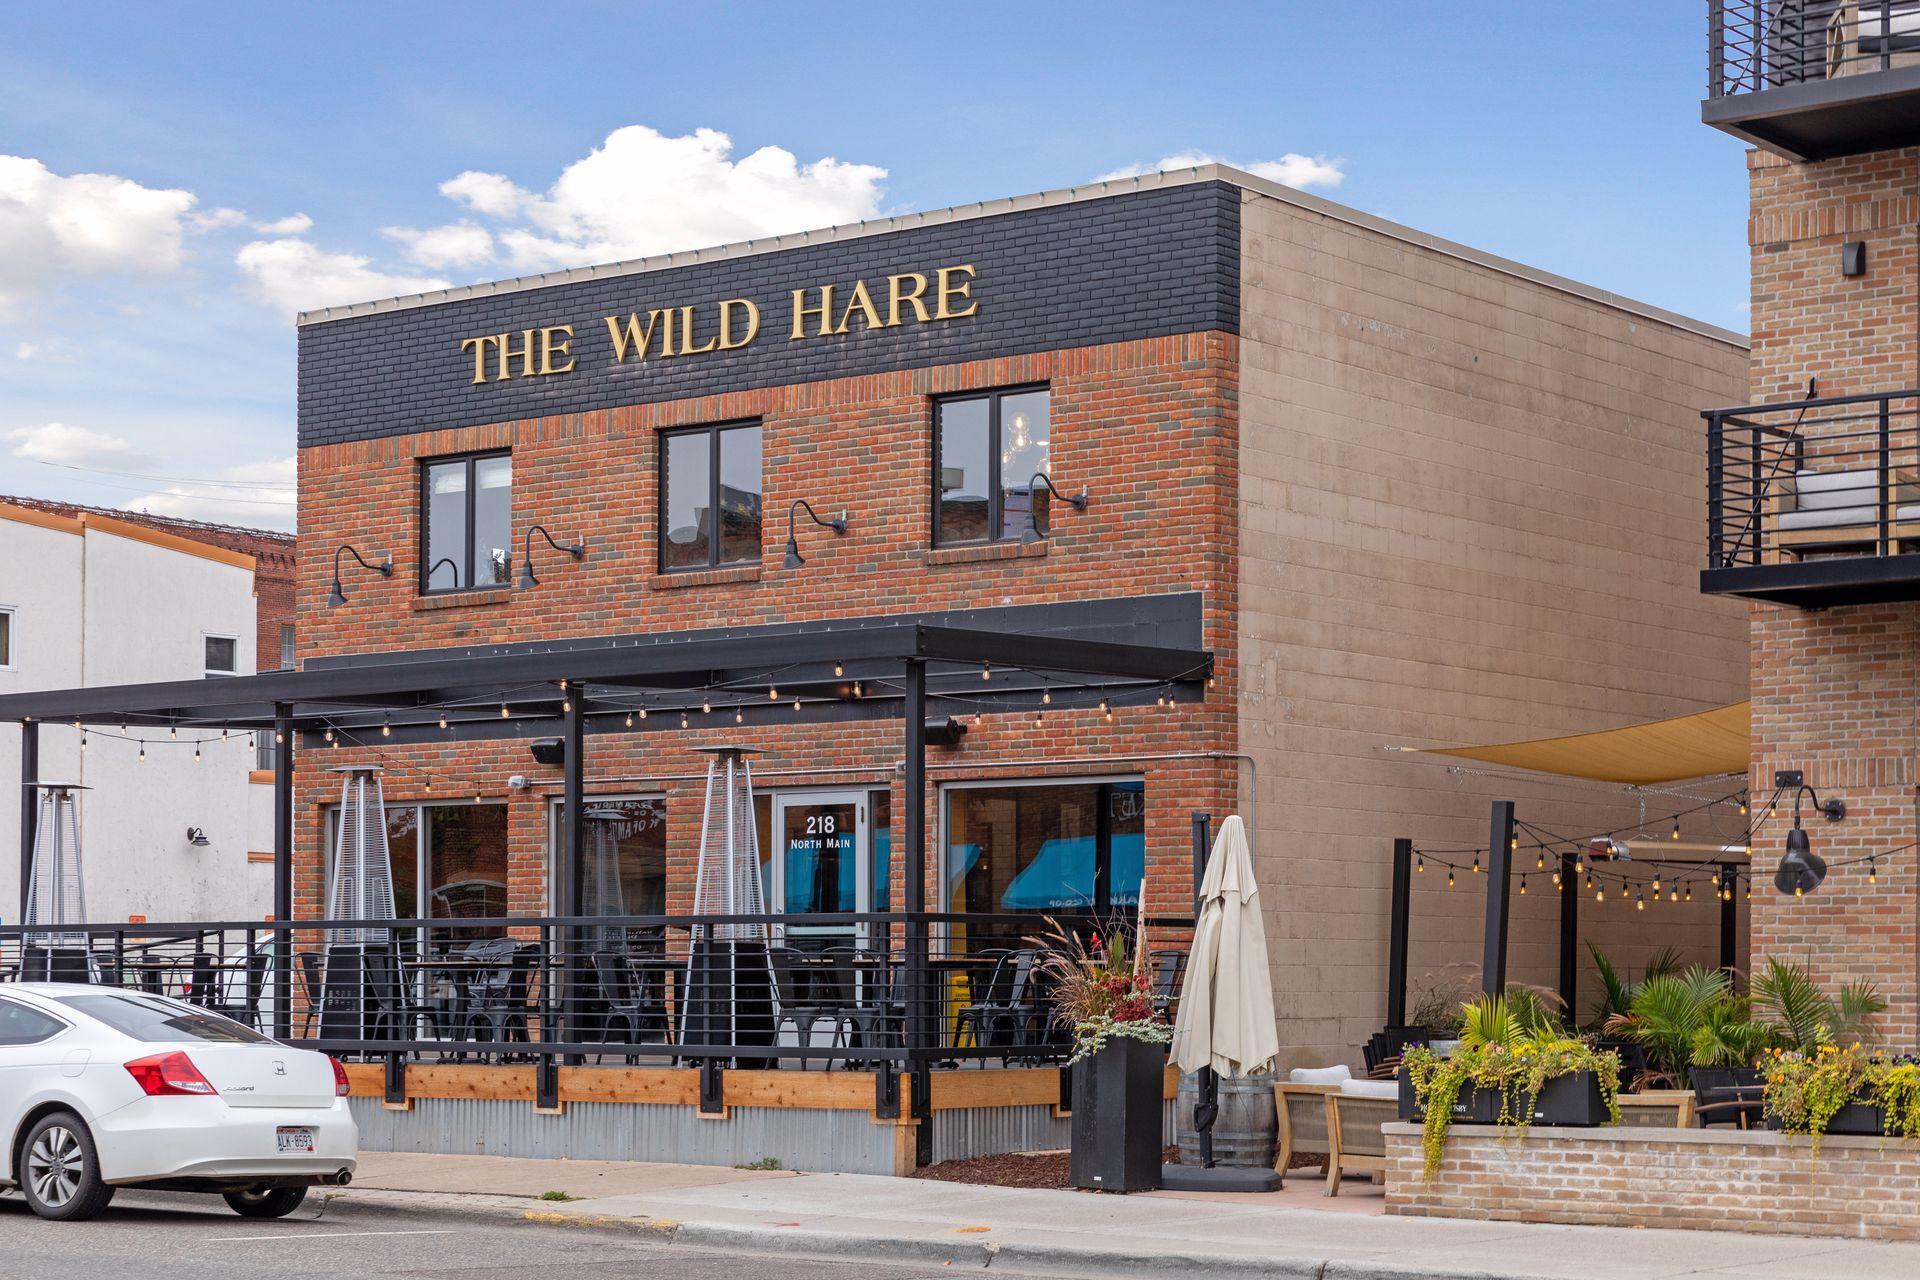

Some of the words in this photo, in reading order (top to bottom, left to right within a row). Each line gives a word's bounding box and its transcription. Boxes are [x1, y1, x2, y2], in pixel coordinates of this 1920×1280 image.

[460, 324, 577, 385] THE
[603, 298, 761, 364] WILD
[789, 264, 979, 340] HARE
[806, 815, 835, 834] 218
[790, 838, 822, 850] NORTH
[826, 838, 850, 849] MAIN
[277, 1135, 313, 1148] ALK-8593
